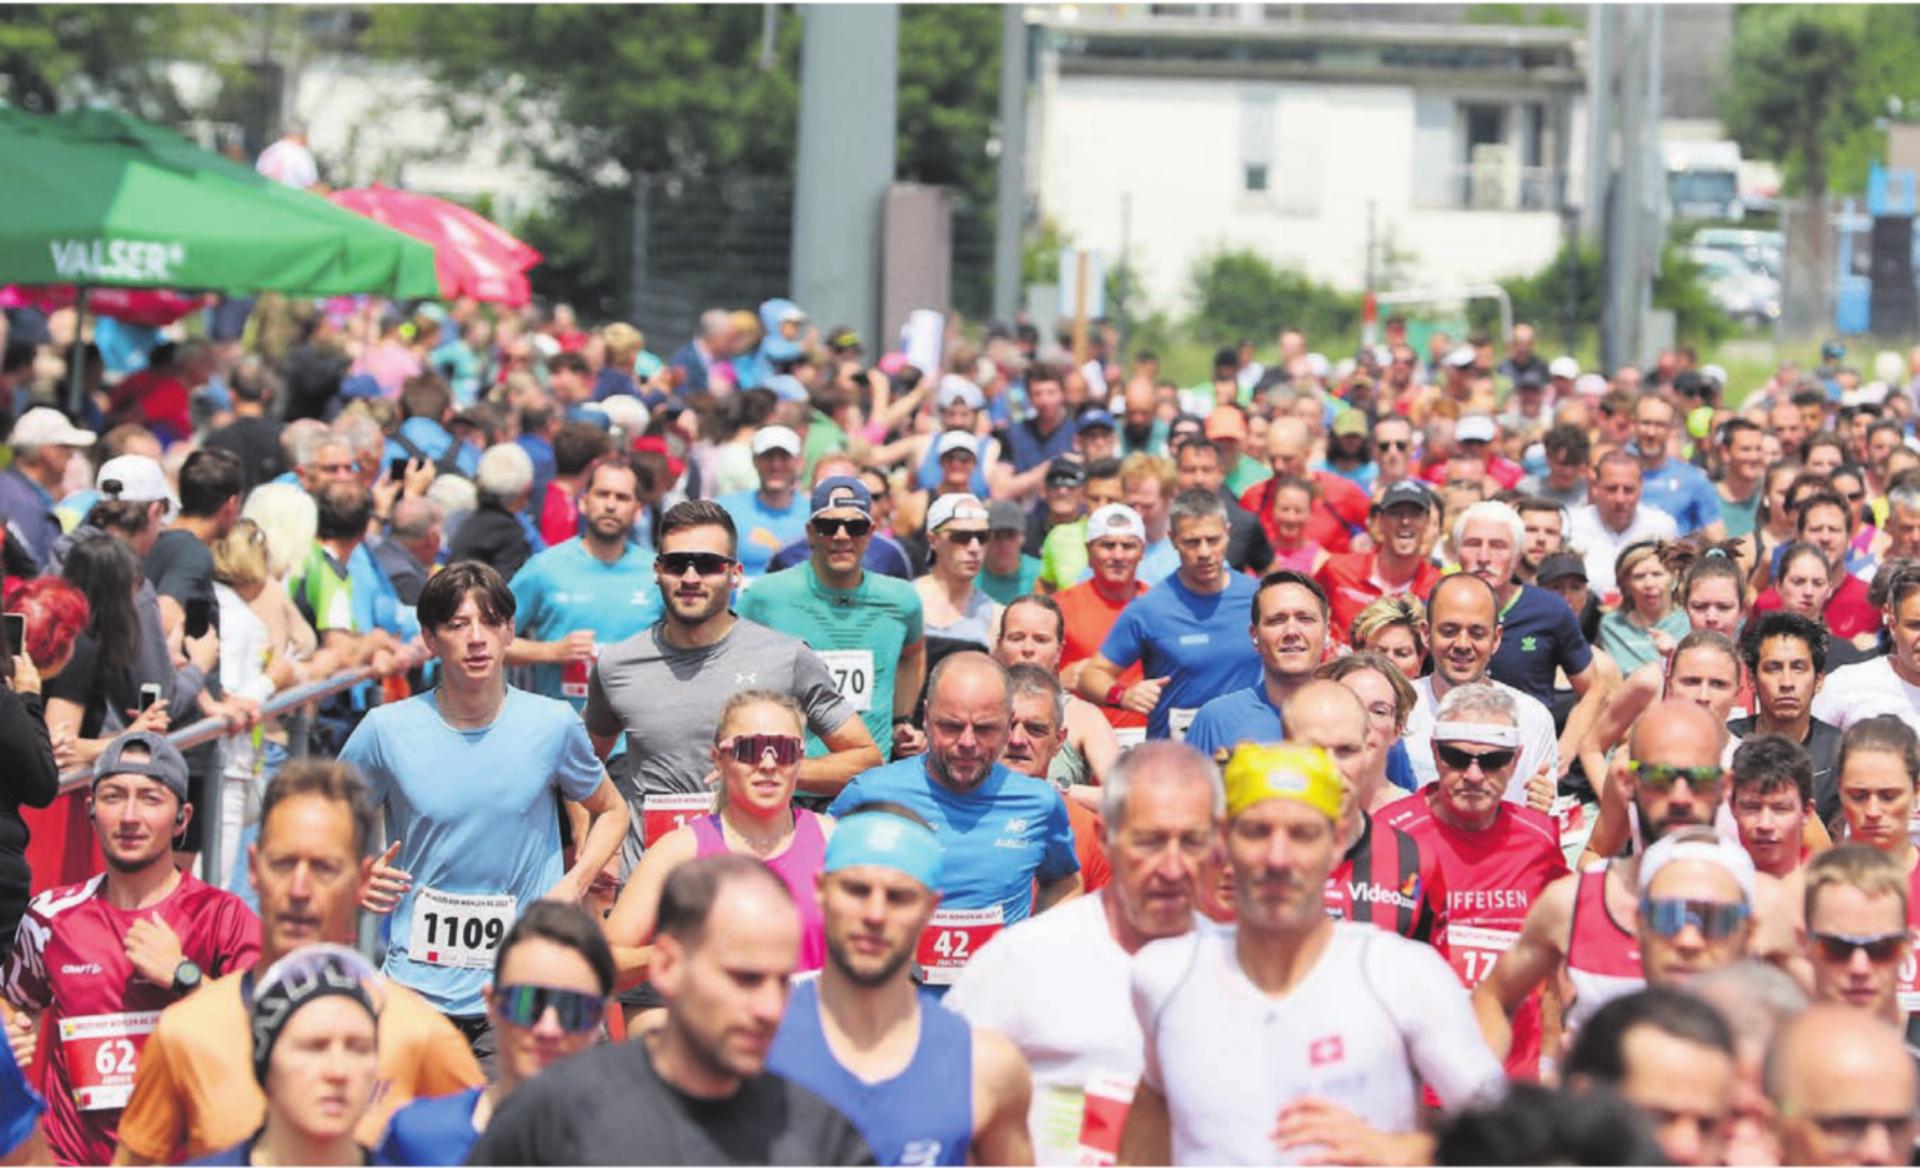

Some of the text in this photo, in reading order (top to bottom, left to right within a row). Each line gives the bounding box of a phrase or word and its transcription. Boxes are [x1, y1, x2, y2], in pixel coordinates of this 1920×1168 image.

[824, 662, 866, 695] 70
[424, 911, 505, 950] 1109
[933, 930, 970, 959] 42
[95, 1039, 137, 1075] 62
